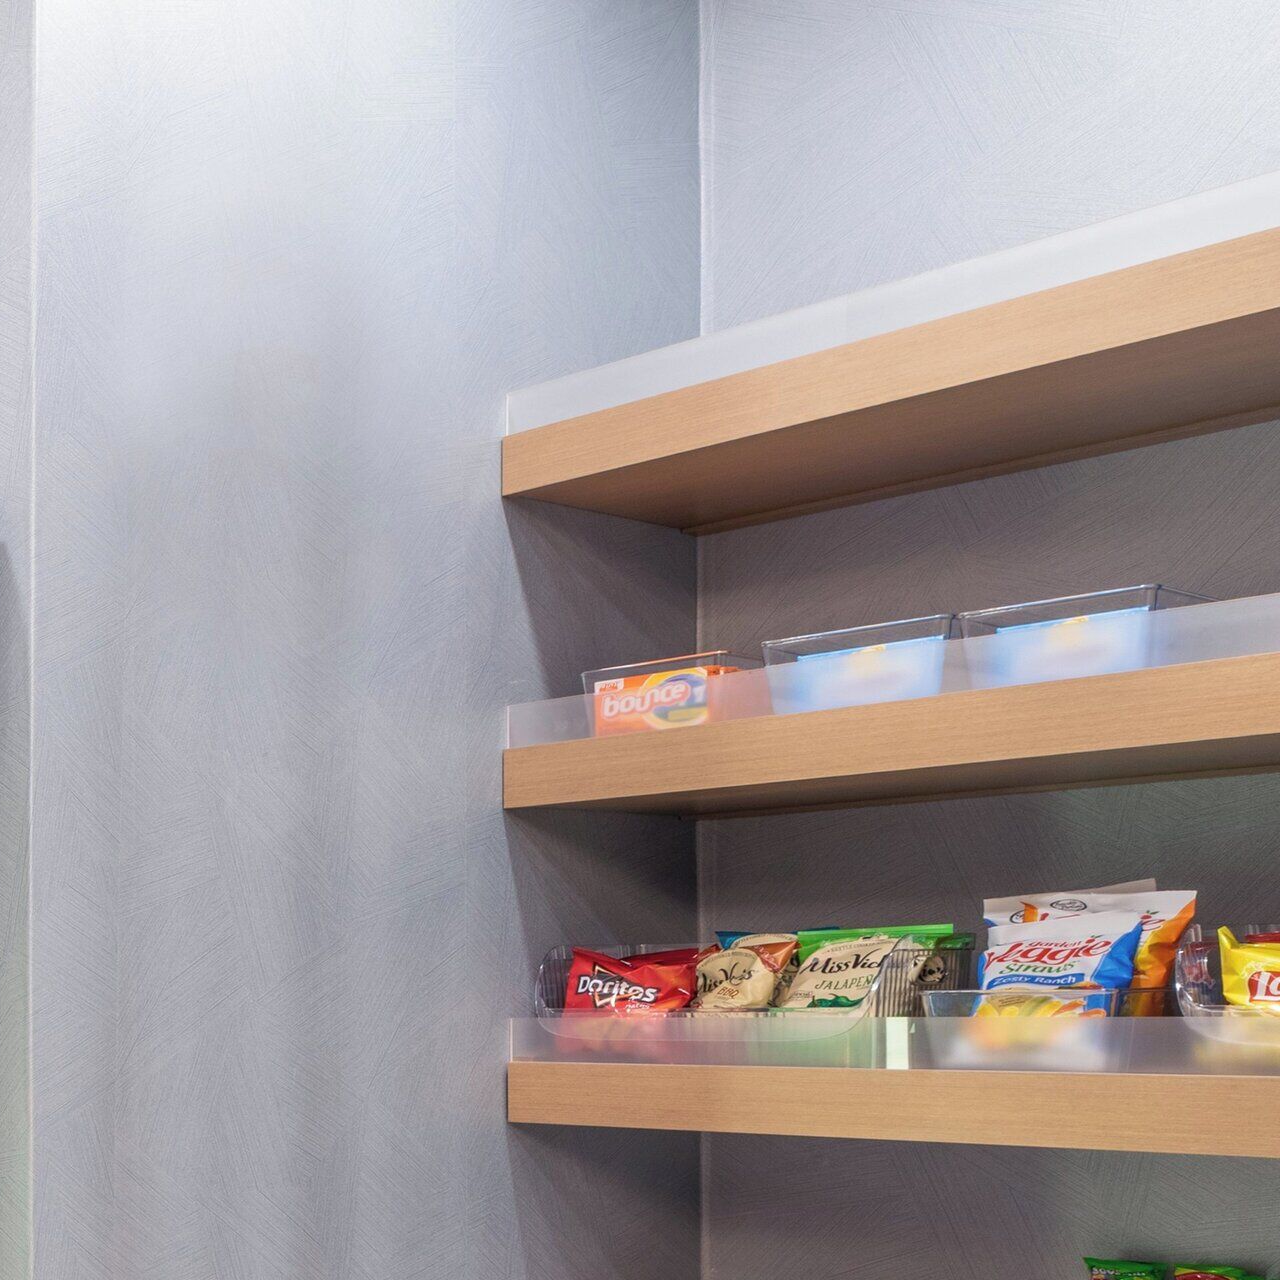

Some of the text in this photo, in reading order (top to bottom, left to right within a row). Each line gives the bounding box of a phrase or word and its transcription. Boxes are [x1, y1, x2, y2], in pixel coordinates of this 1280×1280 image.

[602, 681, 688, 718] bounce
[800, 957, 850, 975] Miss
[999, 960, 1076, 975] Straws
[993, 975, 1076, 987] Zesty Ranch
[577, 975, 659, 1008] Doritos
[716, 987, 740, 1000] BBQ
